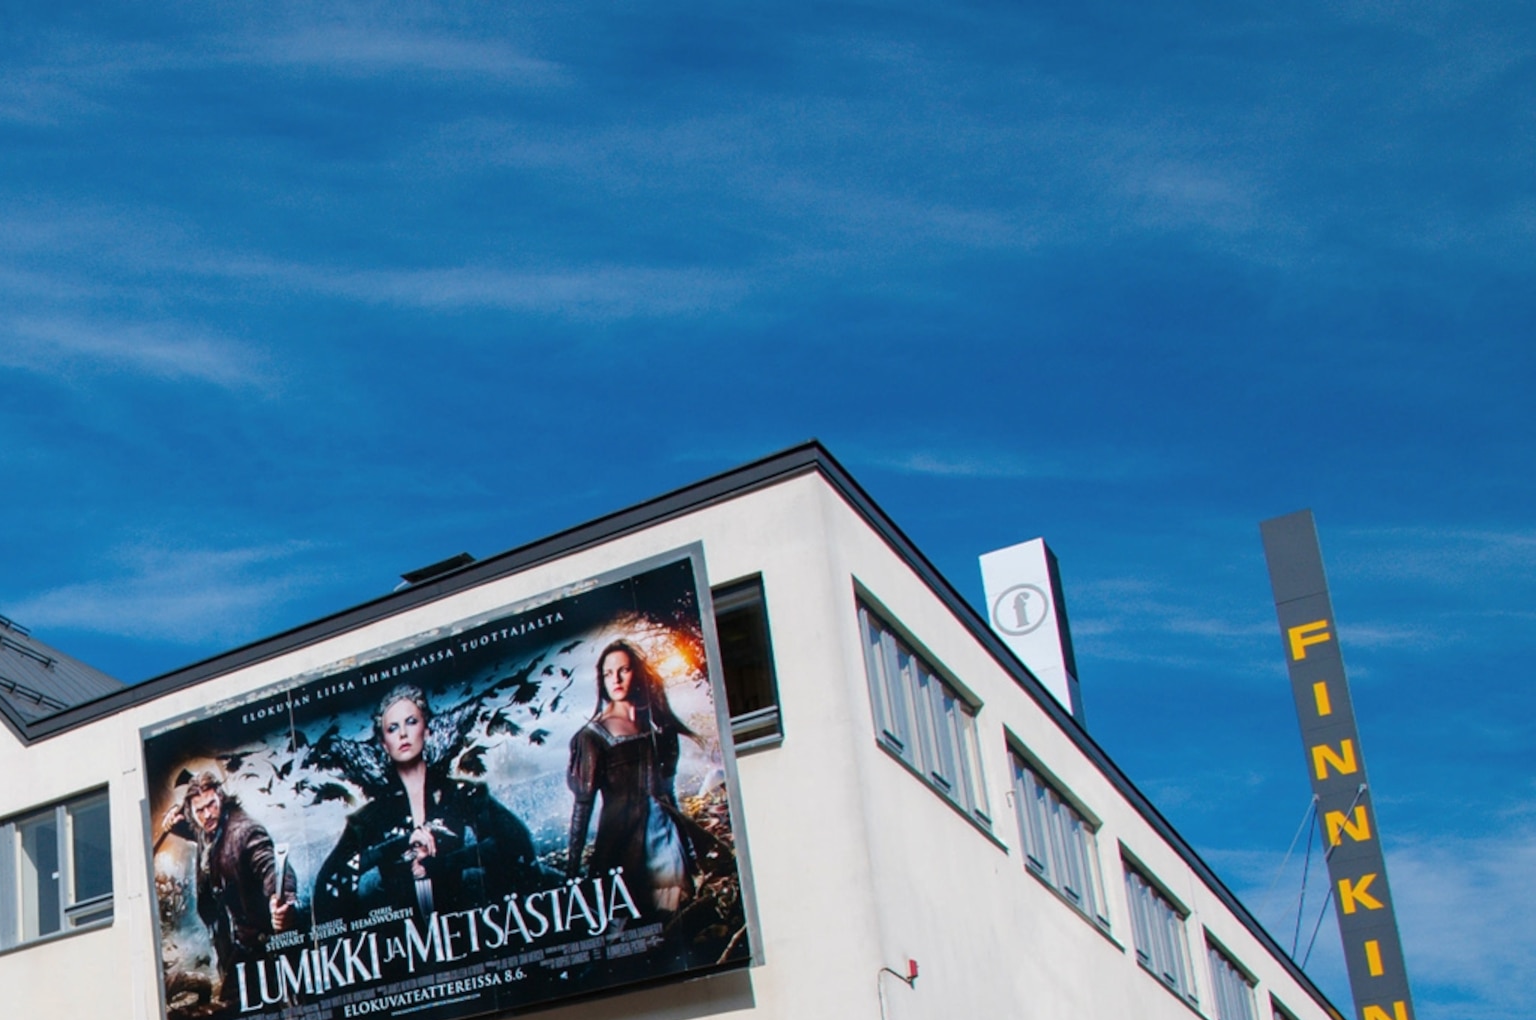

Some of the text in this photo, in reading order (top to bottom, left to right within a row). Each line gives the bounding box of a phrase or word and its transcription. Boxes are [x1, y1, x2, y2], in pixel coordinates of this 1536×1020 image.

[242, 611, 565, 725] ELOKUVAN LIISA IHMEMAASSA TUOTTAJALTA
[350, 907, 414, 931] HEMSWORTH
[368, 905, 393, 917] CHRIS
[235, 930, 383, 1013] LUMIKKI
[384, 936, 405, 964] JA
[403, 865, 642, 973] METSÄSTÄJÄ
[265, 934, 305, 952] STEWART
[308, 923, 348, 942] THERON
[343, 973, 502, 1018] ELOKUVATEATTEREISSA
[504, 967, 528, 984] 8.6.
